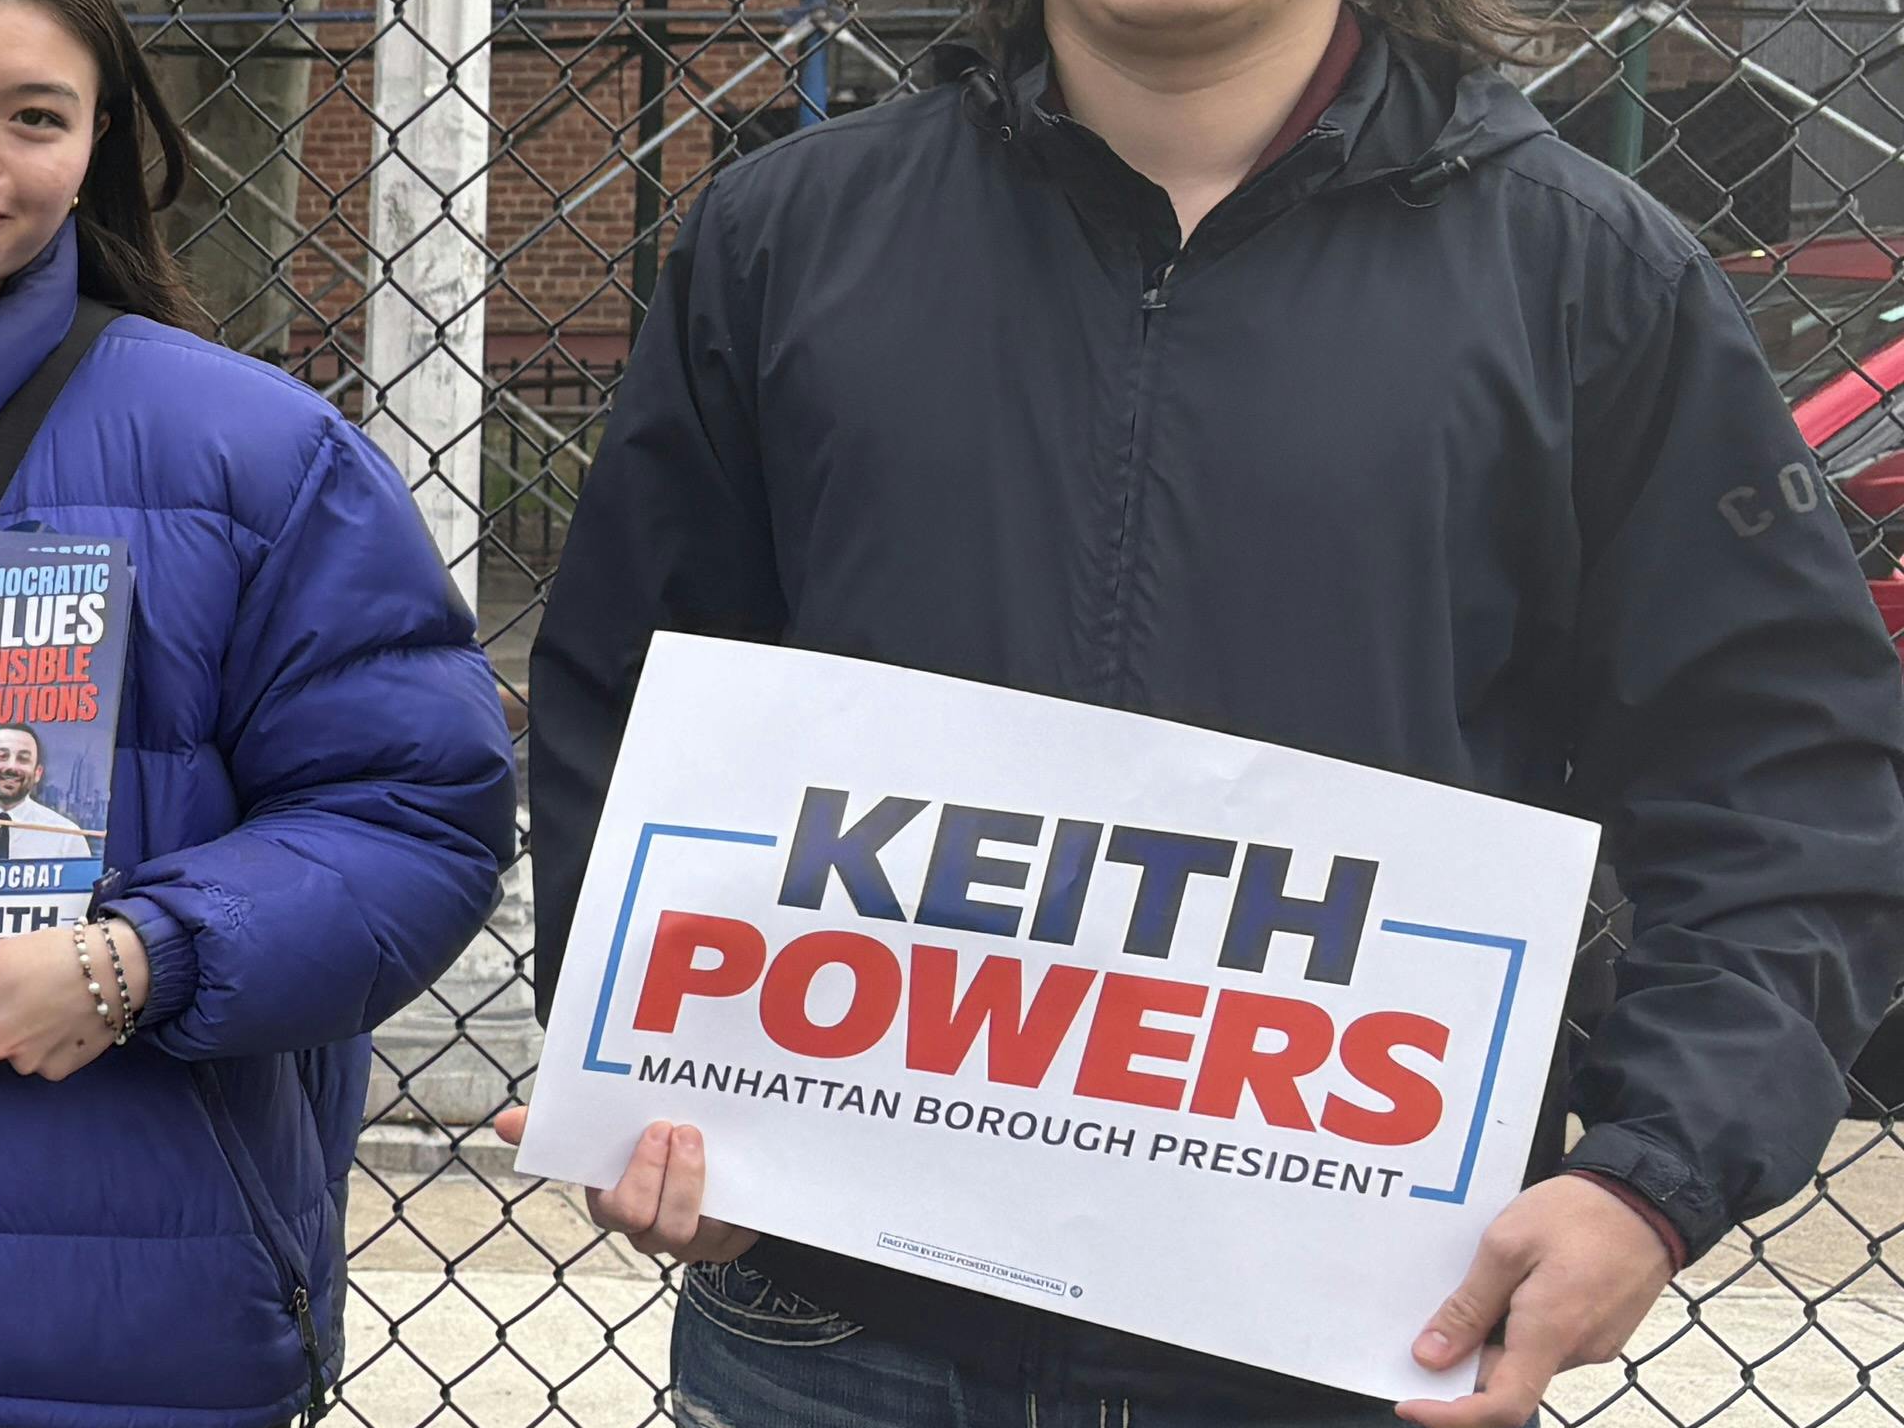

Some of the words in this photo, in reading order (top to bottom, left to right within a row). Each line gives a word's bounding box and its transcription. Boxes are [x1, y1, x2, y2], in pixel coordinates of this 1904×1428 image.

[778, 786, 1379, 986] KEITH
[632, 909, 1450, 1146] POWERS
[638, 1054, 903, 1121] MANHATTAN
[913, 1099, 1137, 1160] BOROUGH
[1149, 1133, 1403, 1200] PRESIDENT
